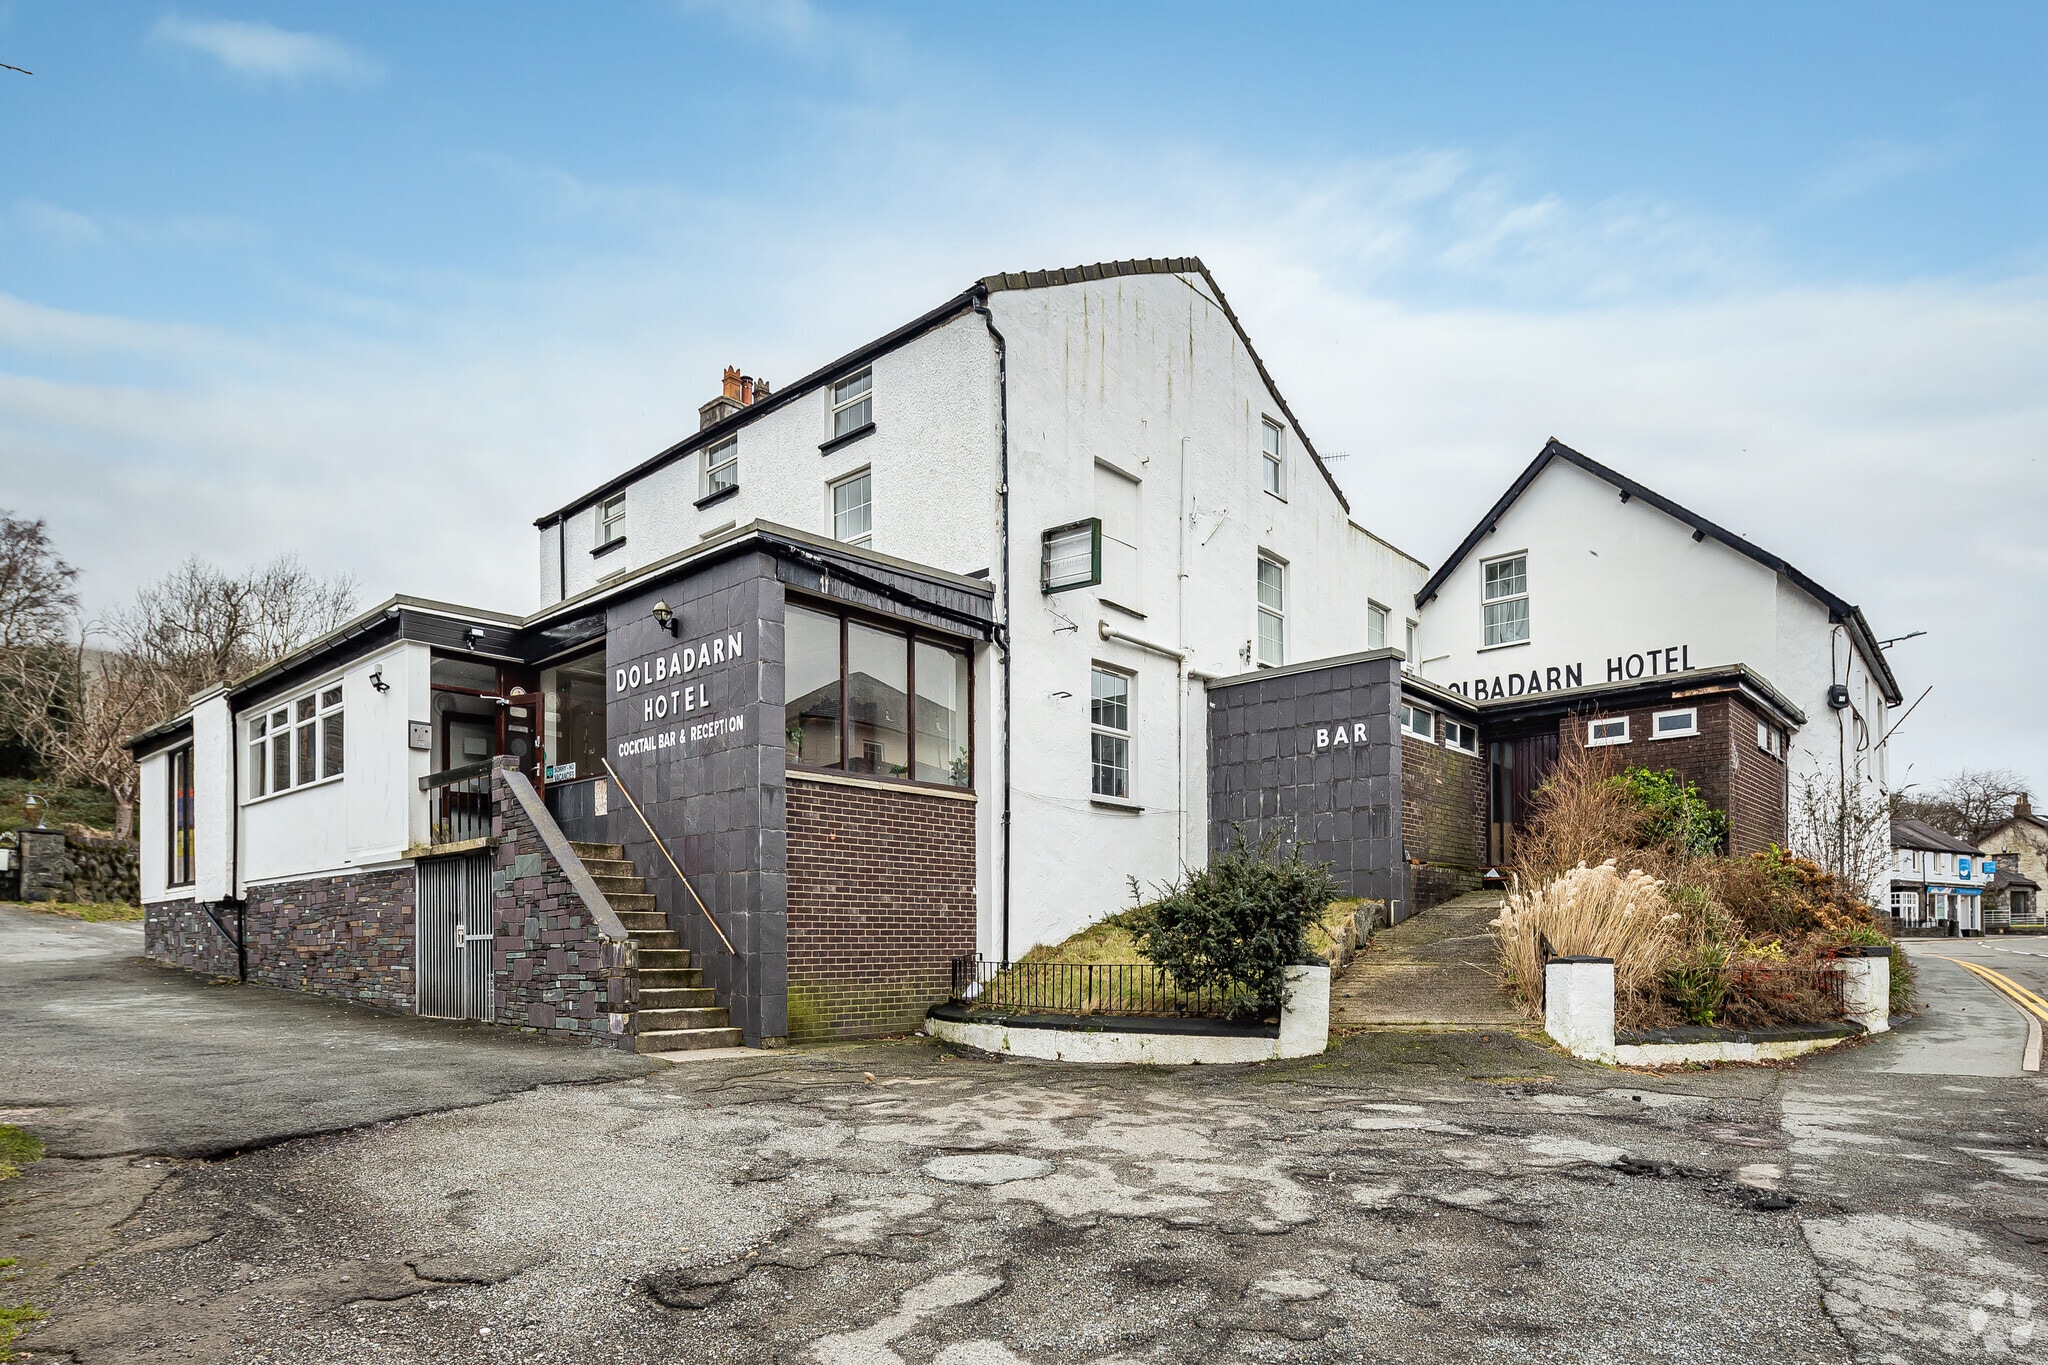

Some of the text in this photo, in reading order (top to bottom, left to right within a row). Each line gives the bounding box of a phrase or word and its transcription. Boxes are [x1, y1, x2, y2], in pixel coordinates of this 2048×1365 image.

[616, 631, 743, 693] DOLBADARN
[1449, 645, 1695, 701] BADARN HOTEL
[644, 683, 710, 722] HOTEL
[618, 714, 744, 757] COCKTAIL BAR & RECEPTION
[1316, 723, 1368, 748] BAR
